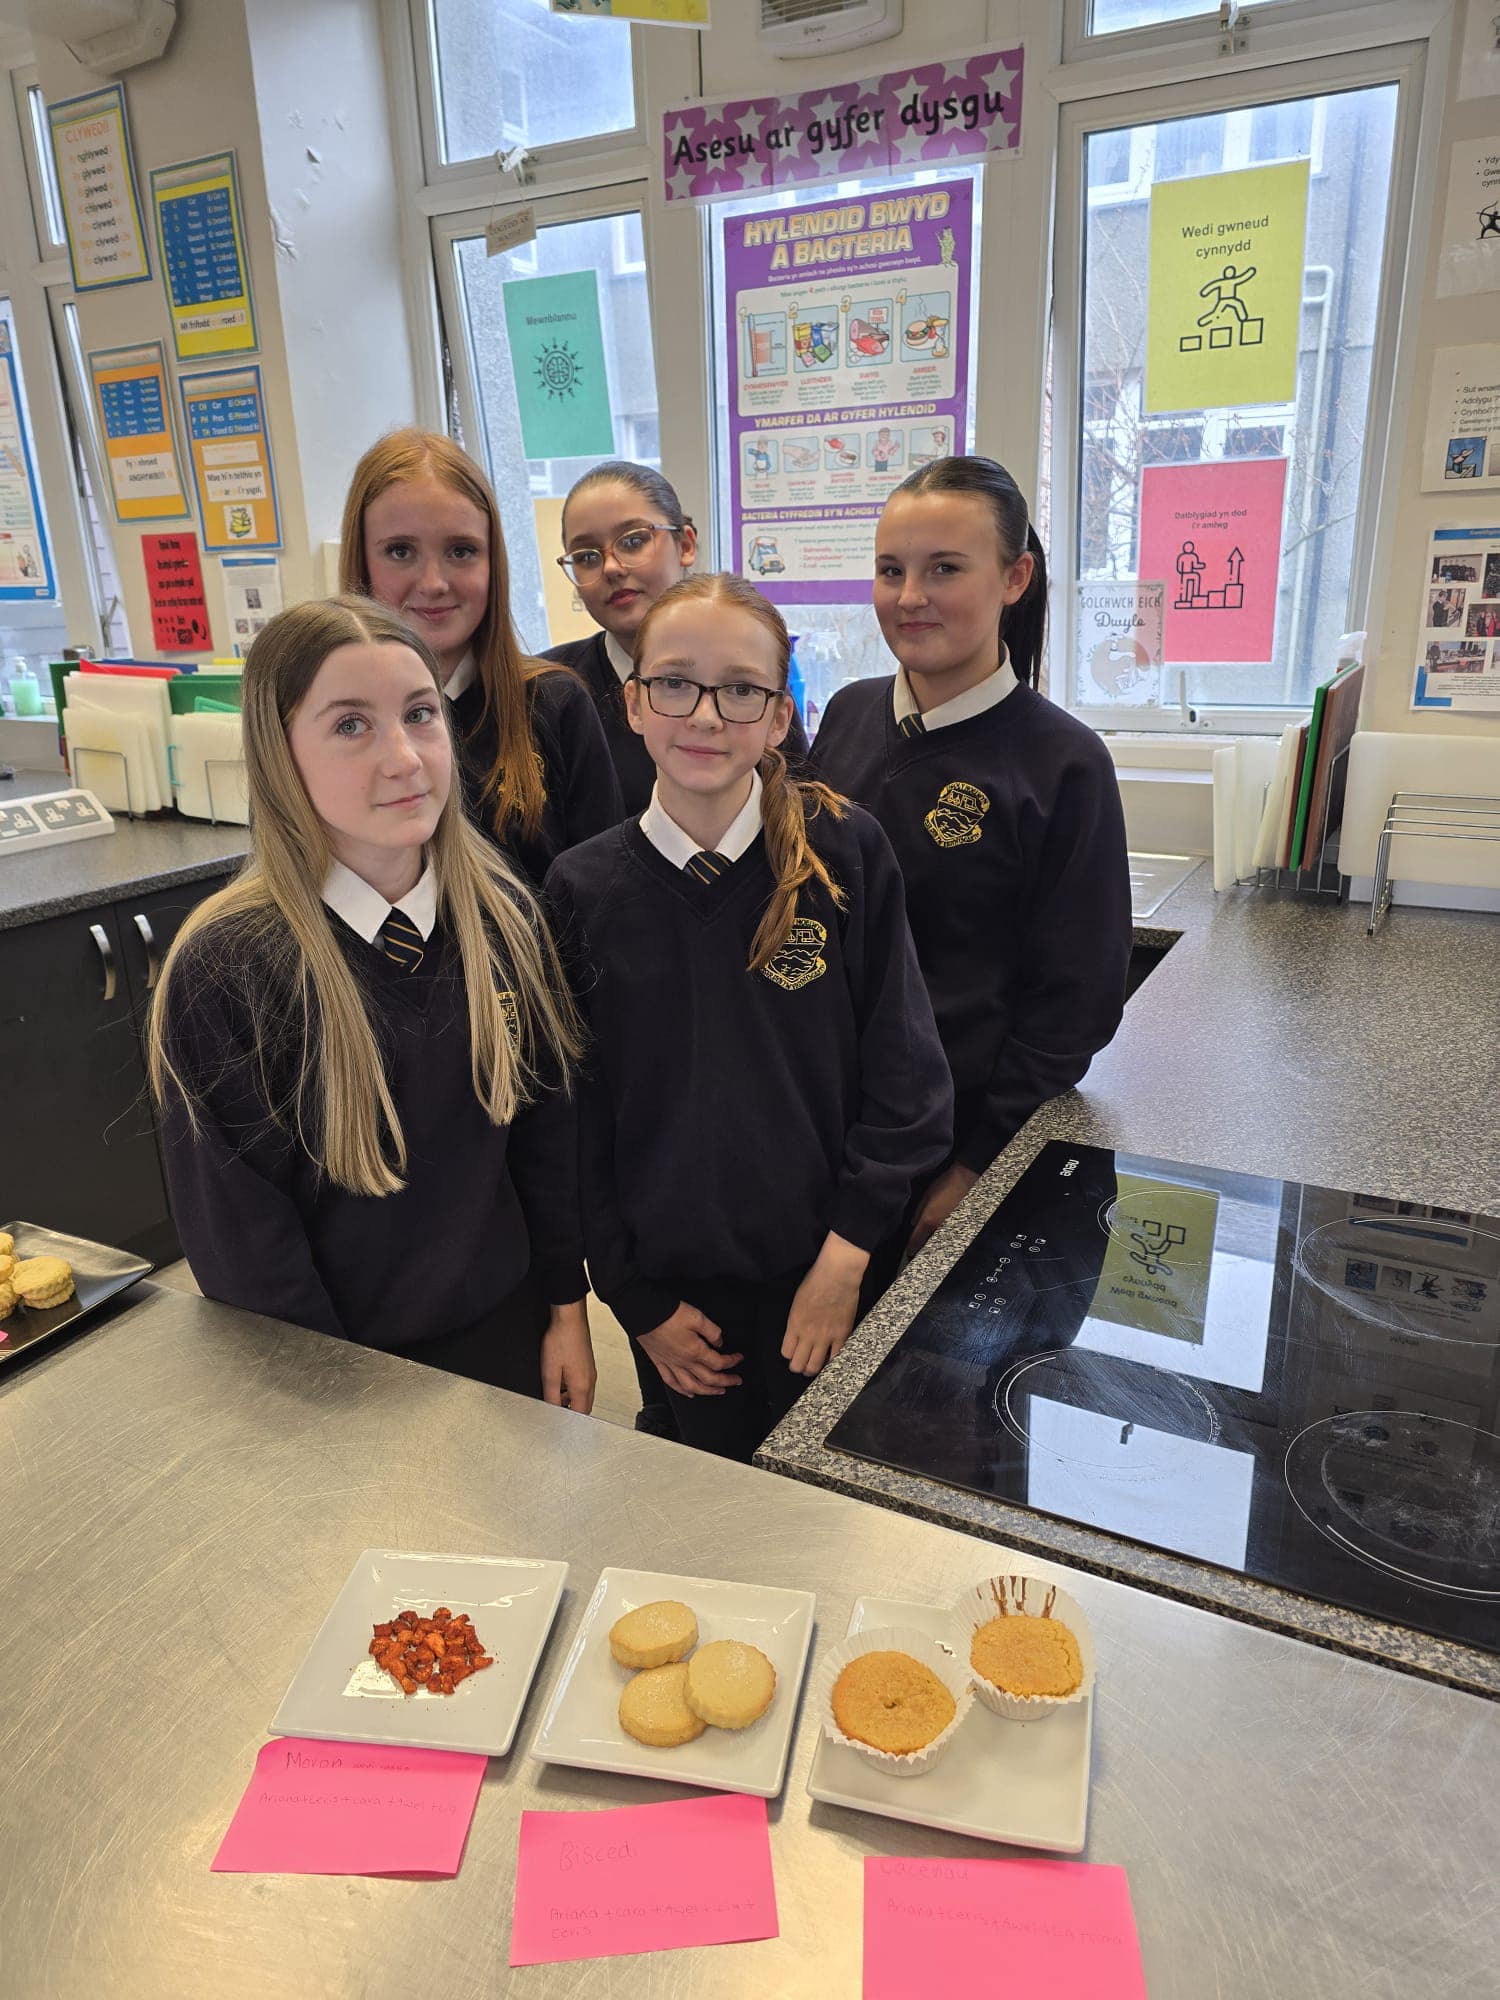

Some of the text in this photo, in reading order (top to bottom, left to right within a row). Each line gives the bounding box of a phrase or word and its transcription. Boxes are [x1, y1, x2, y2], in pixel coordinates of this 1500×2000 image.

[673, 90, 1004, 166] Asesu ar gyfer dysgu
[744, 191, 950, 248] HYLENDID BWYD
[1182, 215, 1269, 238] Wedi gwneud
[771, 226, 913, 270] A BACTERIA
[1196, 239, 1251, 260] cynnydd
[755, 403, 936, 428] YMARFER DA AR GYFER HYLENDID
[1231, 508, 1247, 516] dod
[1081, 597, 1160, 608] GOLCHWCH EICH
[1095, 611, 1146, 633] Dwylo
